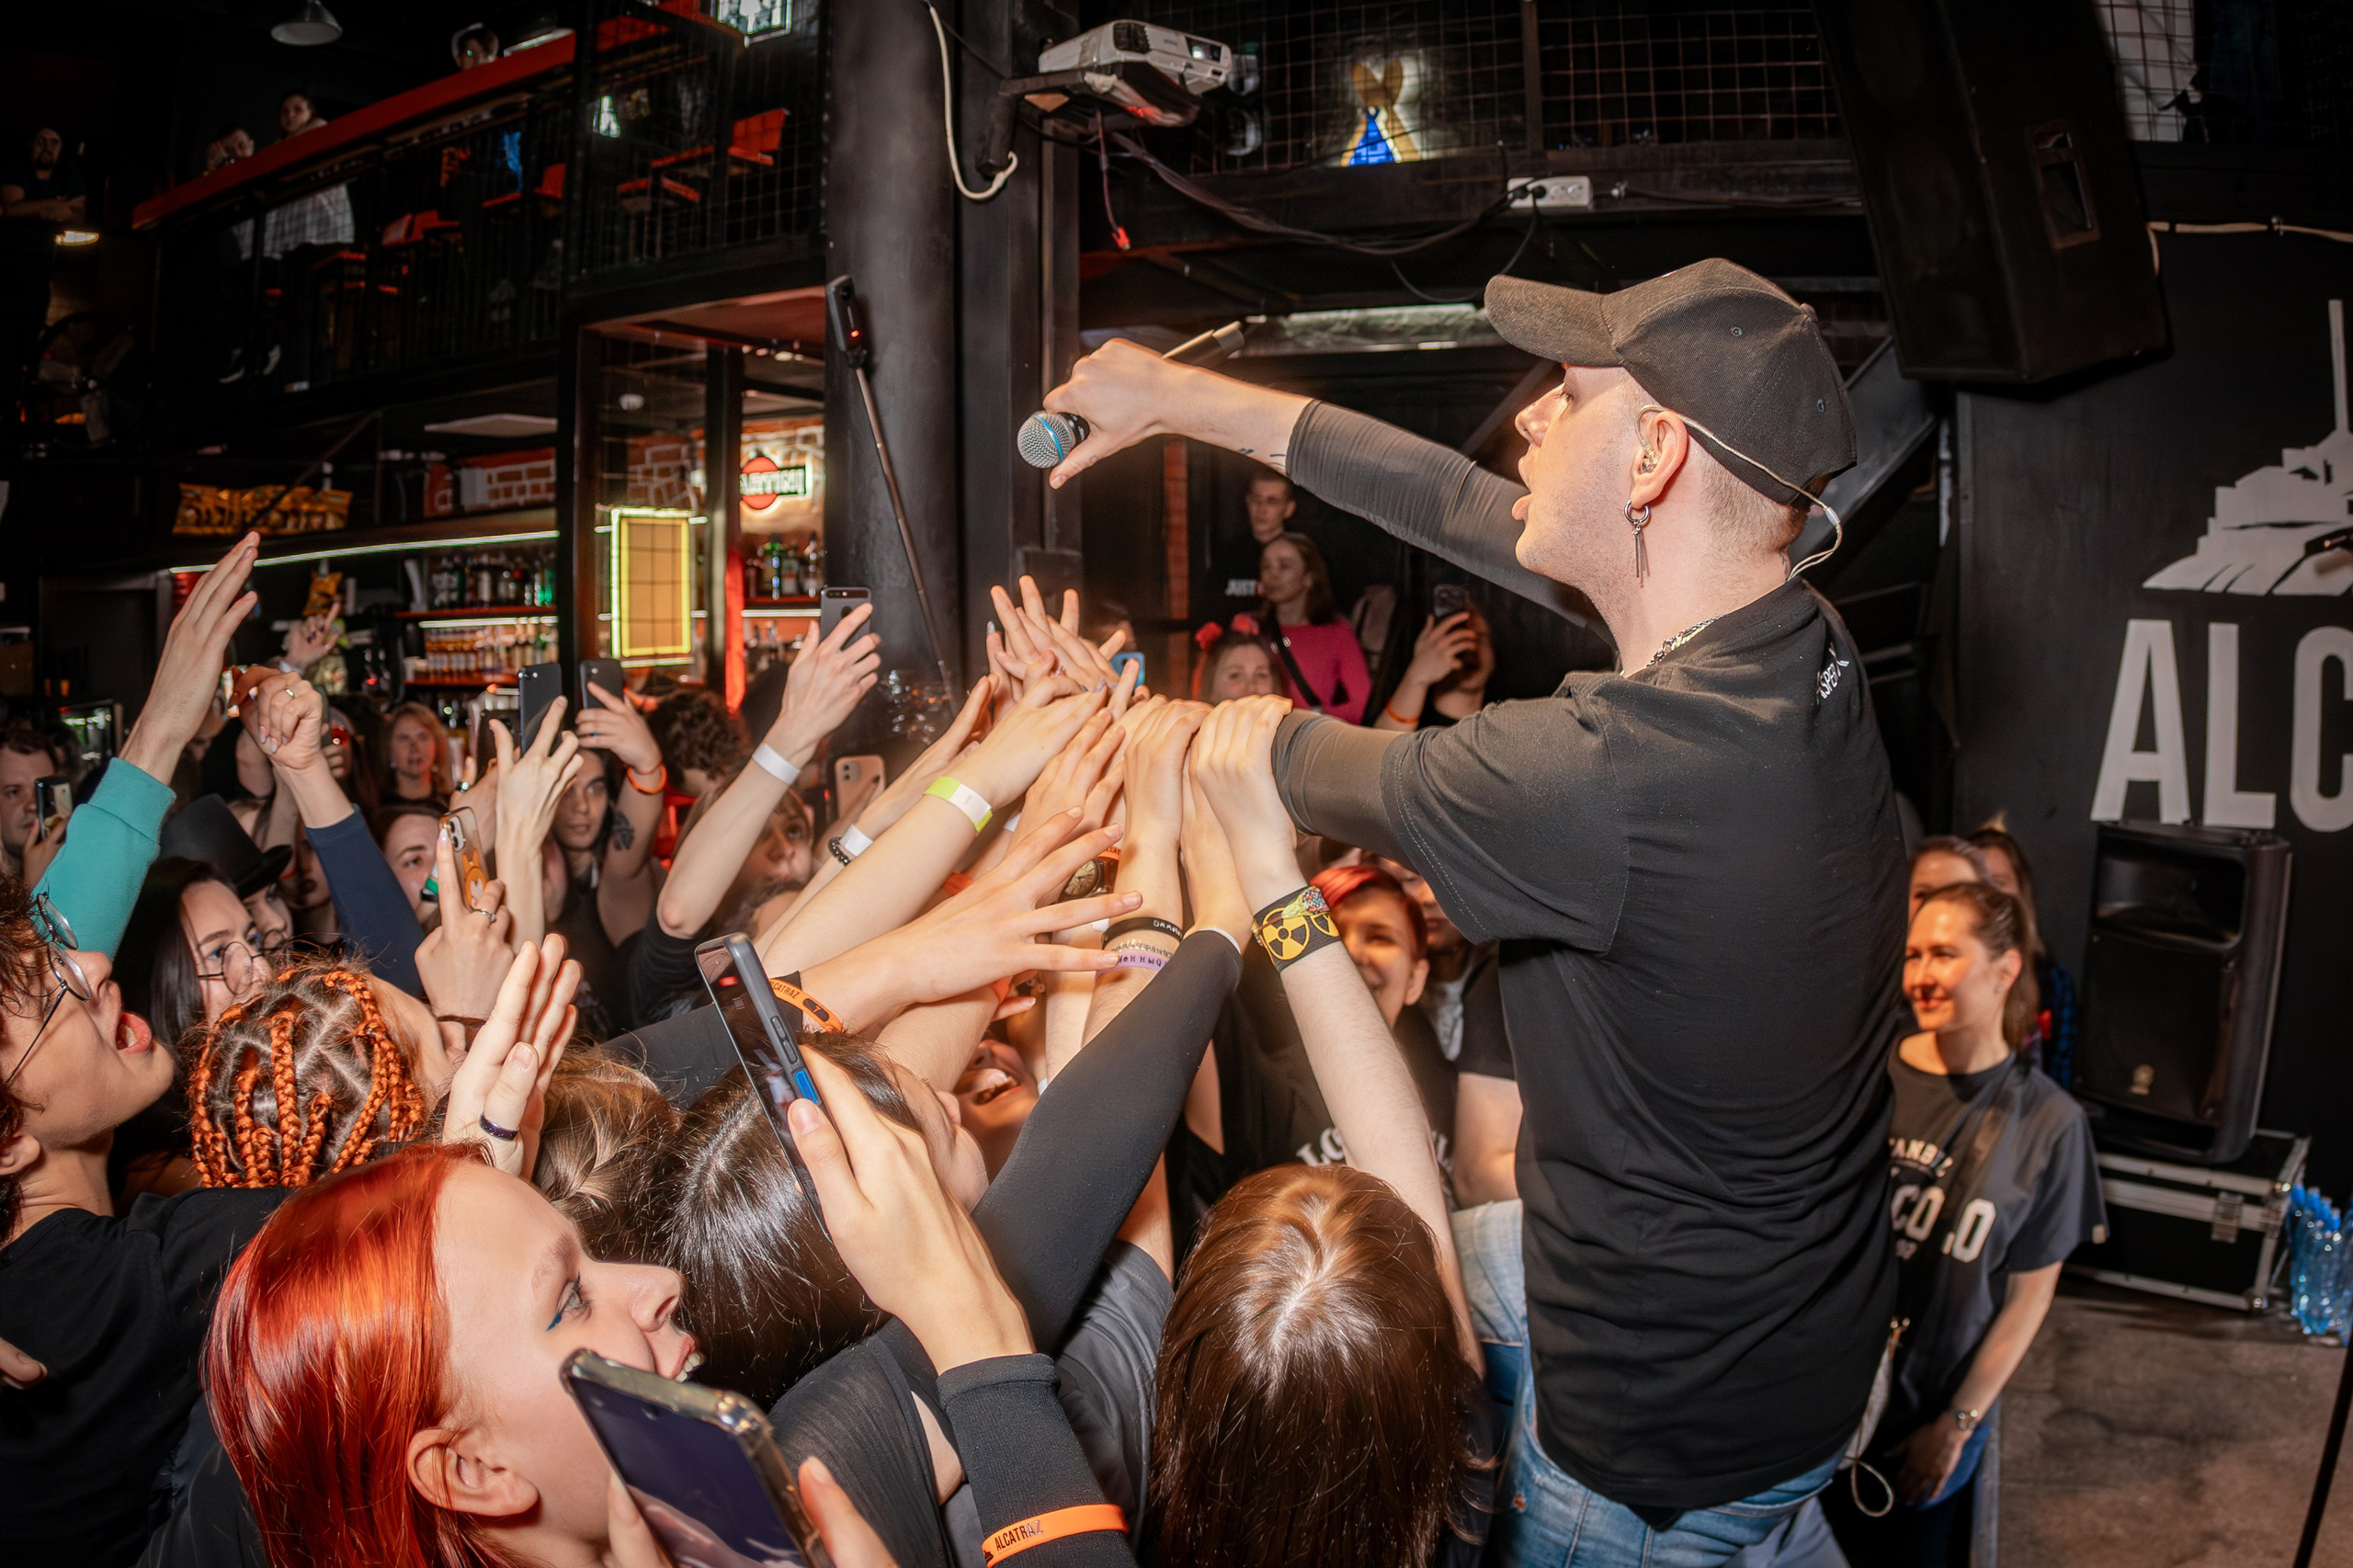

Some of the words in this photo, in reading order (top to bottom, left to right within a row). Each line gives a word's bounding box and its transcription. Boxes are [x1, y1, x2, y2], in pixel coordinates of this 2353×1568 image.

[739, 469, 805, 494] ARTINI
[2090, 618, 2353, 833] ALC
[994, 1519, 1044, 1551] ALCATRAZ
